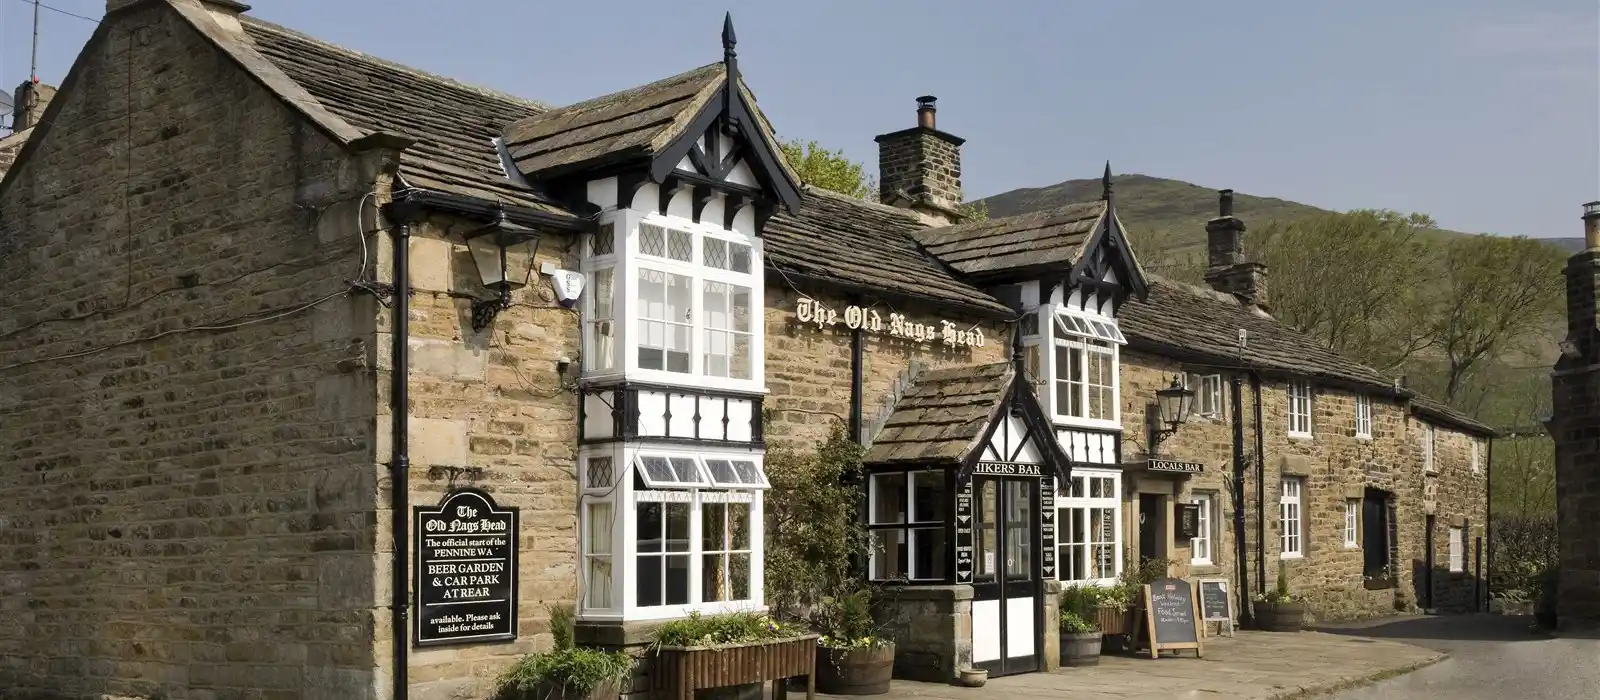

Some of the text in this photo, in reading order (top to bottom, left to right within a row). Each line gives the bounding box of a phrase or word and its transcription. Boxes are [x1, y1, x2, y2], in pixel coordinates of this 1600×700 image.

[797, 297, 985, 348] The Old Nags Head
[1018, 464, 1041, 475] BAR
[1153, 460, 1201, 472] LOCALS BAR
[456, 505, 478, 519] The
[425, 518, 506, 533] Old Nags Head
[425, 538, 441, 547] The
[442, 538, 468, 547] official
[486, 537, 495, 546] of
[494, 537, 506, 546] the
[434, 548, 476, 557] PENNINE
[428, 562, 504, 574] BEER GARDEN
[432, 574, 500, 586] & CAR PARK
[443, 587, 490, 598] AT REAR
[430, 611, 501, 624] available. Please ask
[438, 621, 494, 633] inside for details
